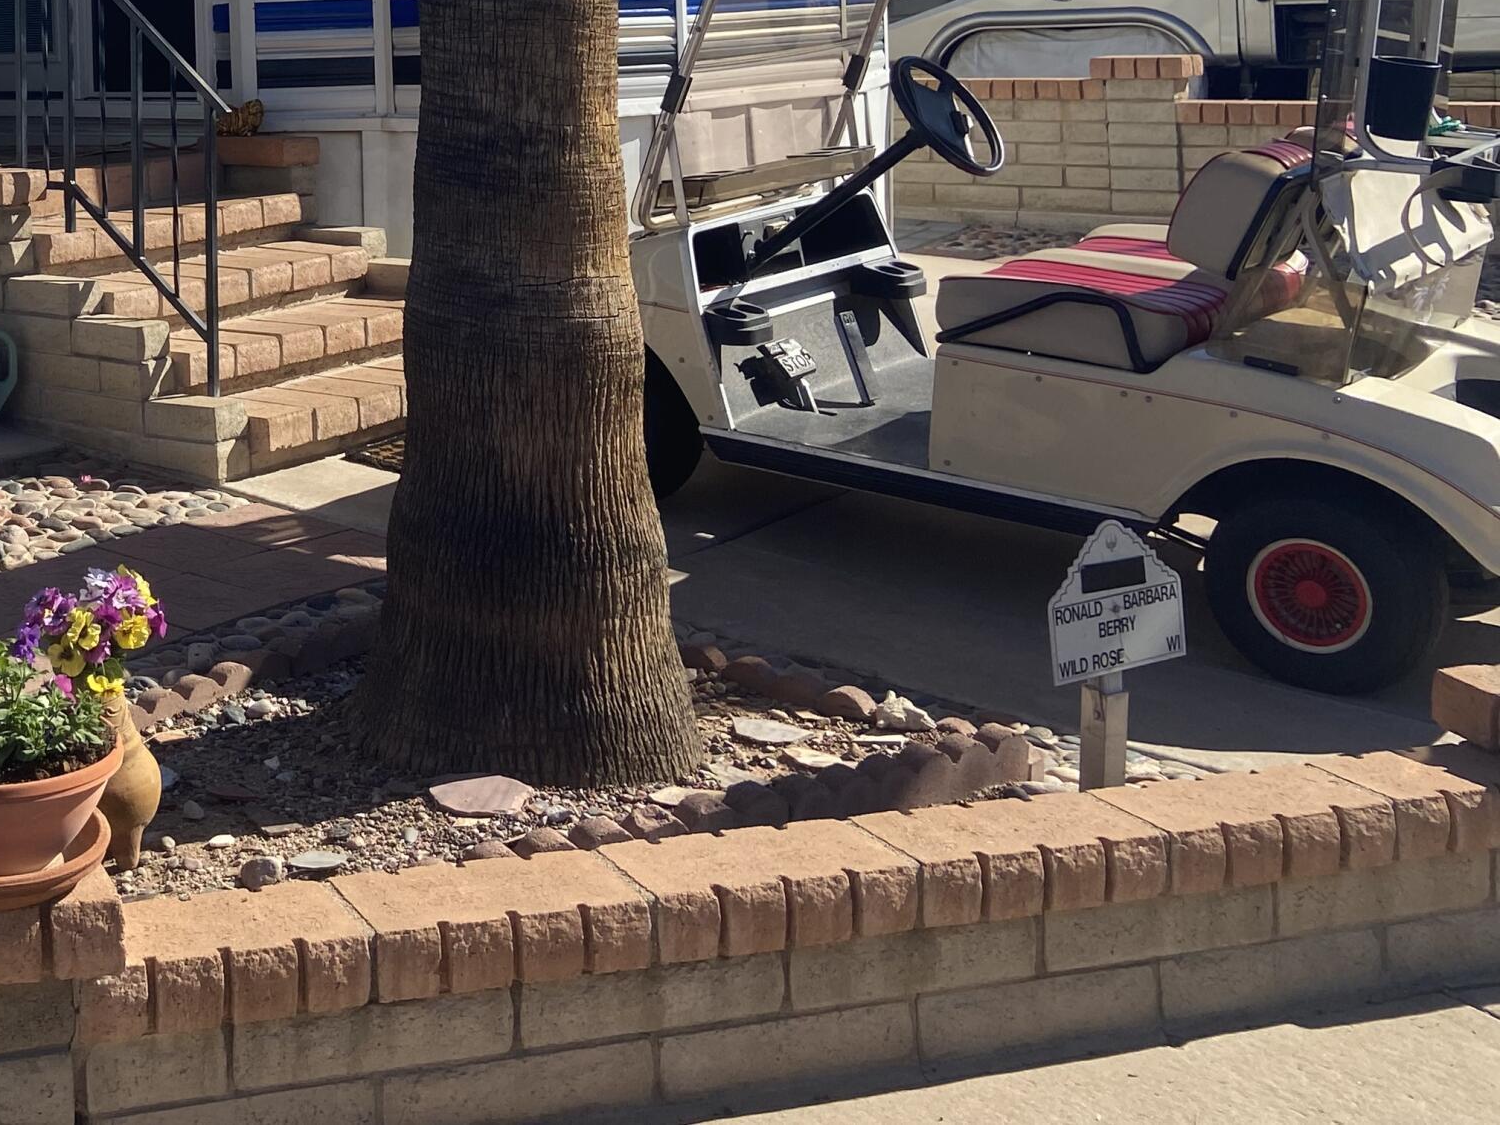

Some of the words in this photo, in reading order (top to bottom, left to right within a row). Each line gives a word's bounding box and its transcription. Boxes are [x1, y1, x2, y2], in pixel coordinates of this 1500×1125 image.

[843, 313, 855, 324] GO
[782, 349, 812, 372] STOP
[1055, 601, 1103, 625] RONALD
[1123, 585, 1177, 610] BARBARA
[1099, 615, 1136, 638] BERRY
[1060, 657, 1088, 678] WILD
[1093, 648, 1124, 670] ROSE
[1167, 635, 1181, 651] WI
